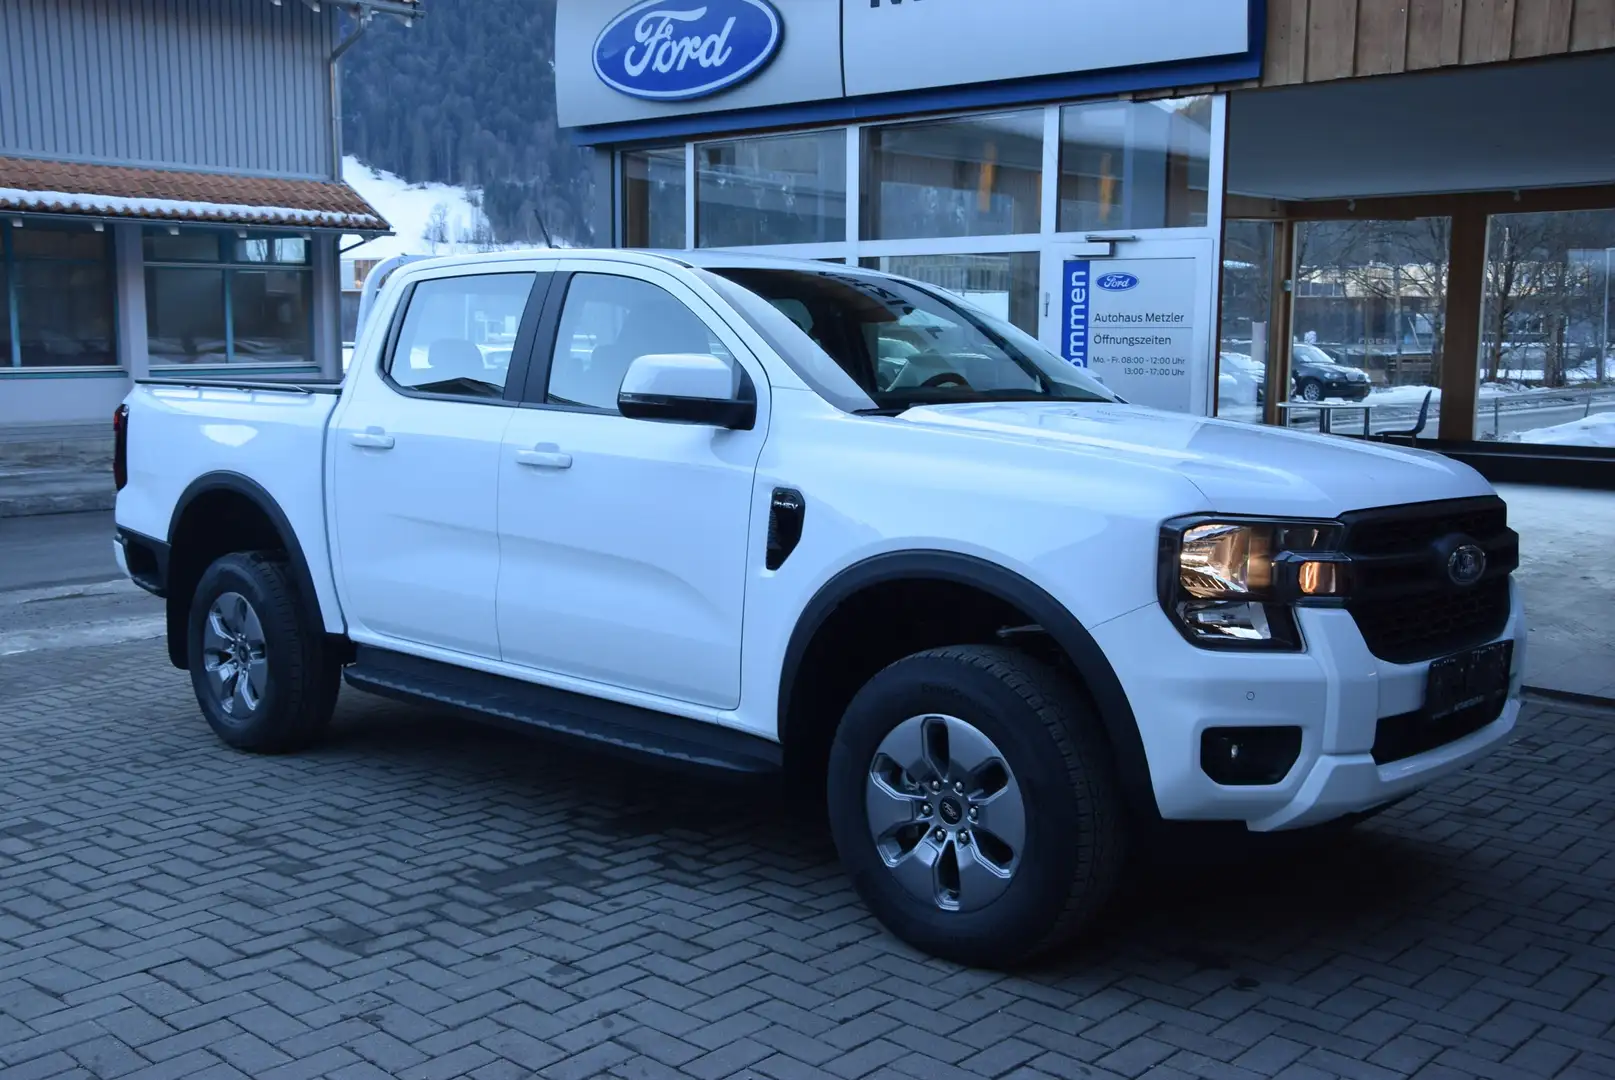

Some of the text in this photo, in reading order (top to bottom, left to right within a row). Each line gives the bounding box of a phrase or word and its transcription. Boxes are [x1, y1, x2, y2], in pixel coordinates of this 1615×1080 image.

[624, 6, 736, 77] Ford
[1103, 275, 1130, 288] Ford
[1094, 312, 1184, 323] Autohaus Metzler
[1093, 333, 1172, 347] Öffnungszeiten
[1121, 356, 1144, 364] 08:00
[1150, 357, 1171, 365] 12:00
[1172, 357, 1185, 365] Uhr
[1124, 367, 1144, 375] 13:00
[1150, 368, 1170, 376] 17:00
[1171, 368, 1185, 376] Uhr
